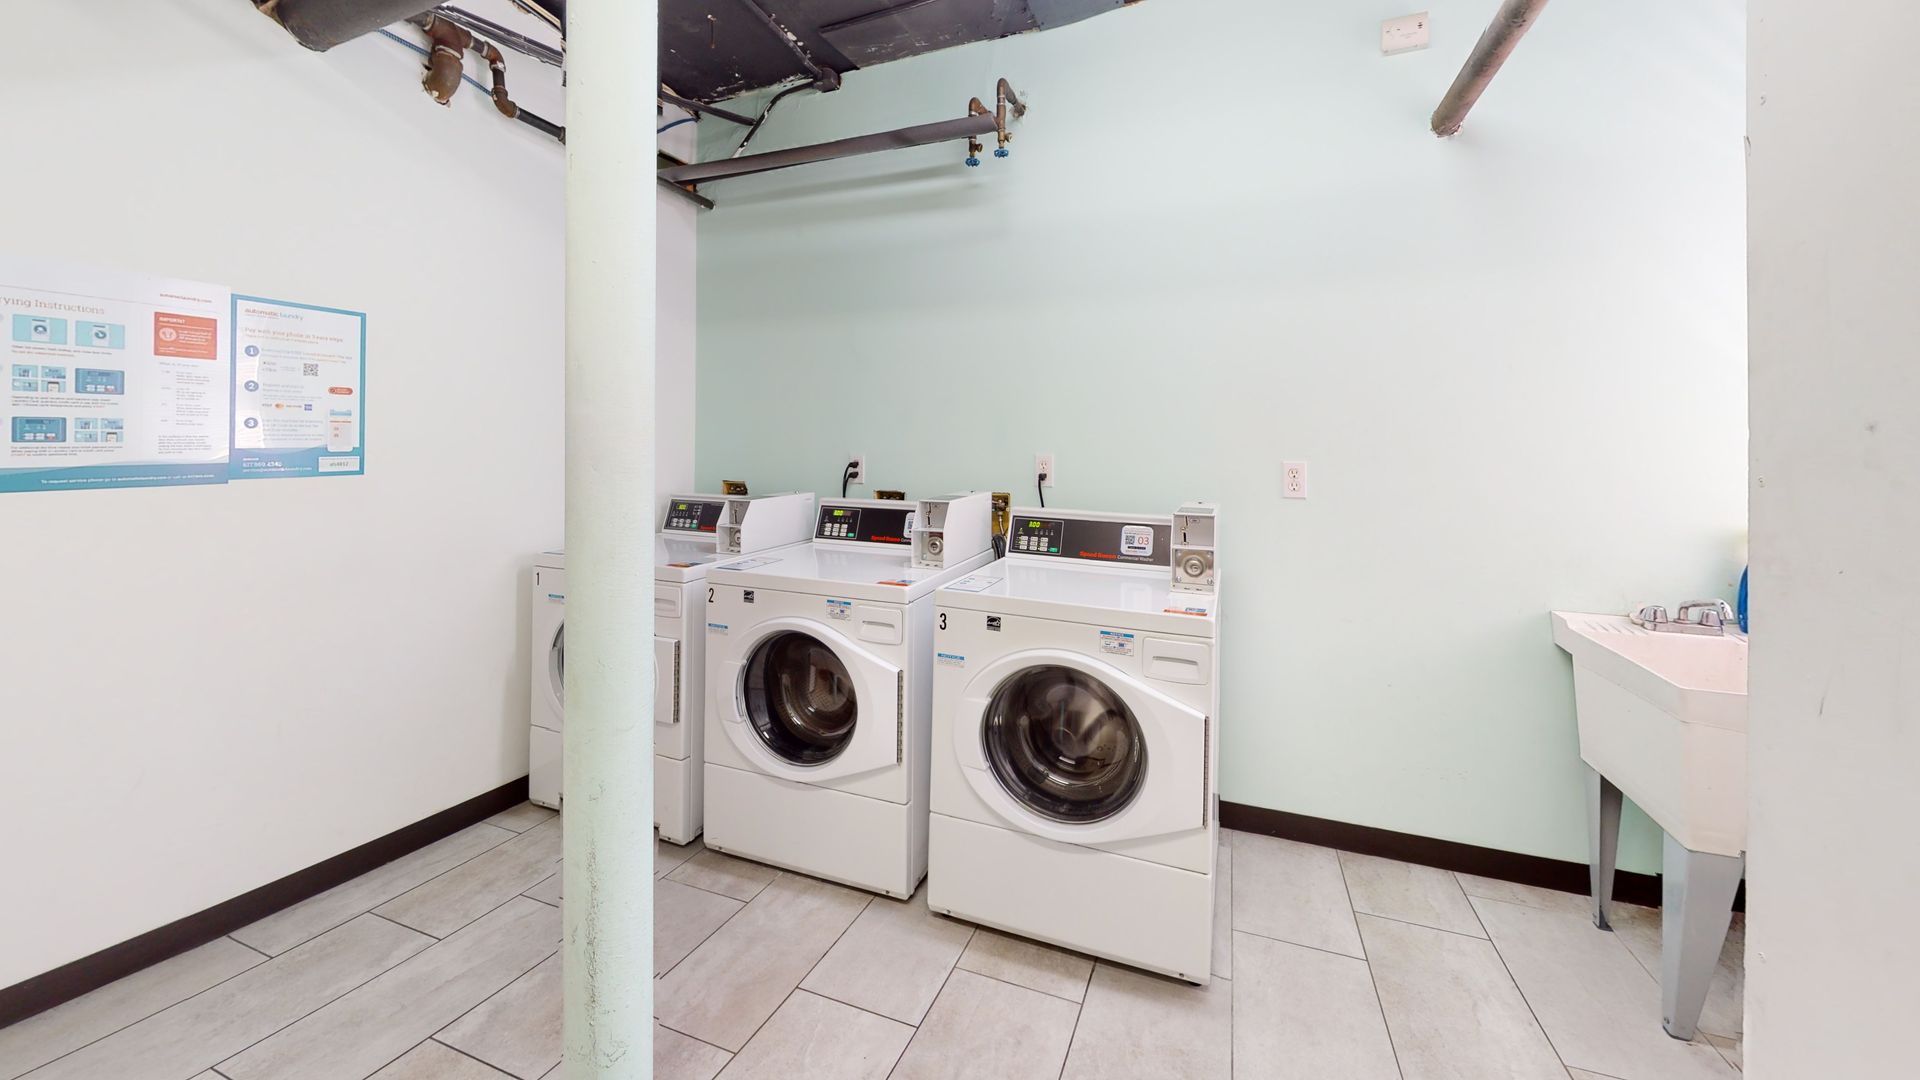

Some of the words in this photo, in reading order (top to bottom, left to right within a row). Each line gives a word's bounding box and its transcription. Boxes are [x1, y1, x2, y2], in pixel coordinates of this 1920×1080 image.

[35, 298, 105, 315] Instructions
[248, 381, 256, 390] 2
[247, 419, 255, 427] 3
[1137, 536, 1150, 546] 03
[536, 572, 540, 586] 1
[708, 587, 714, 603] 2
[939, 612, 947, 631] 3
